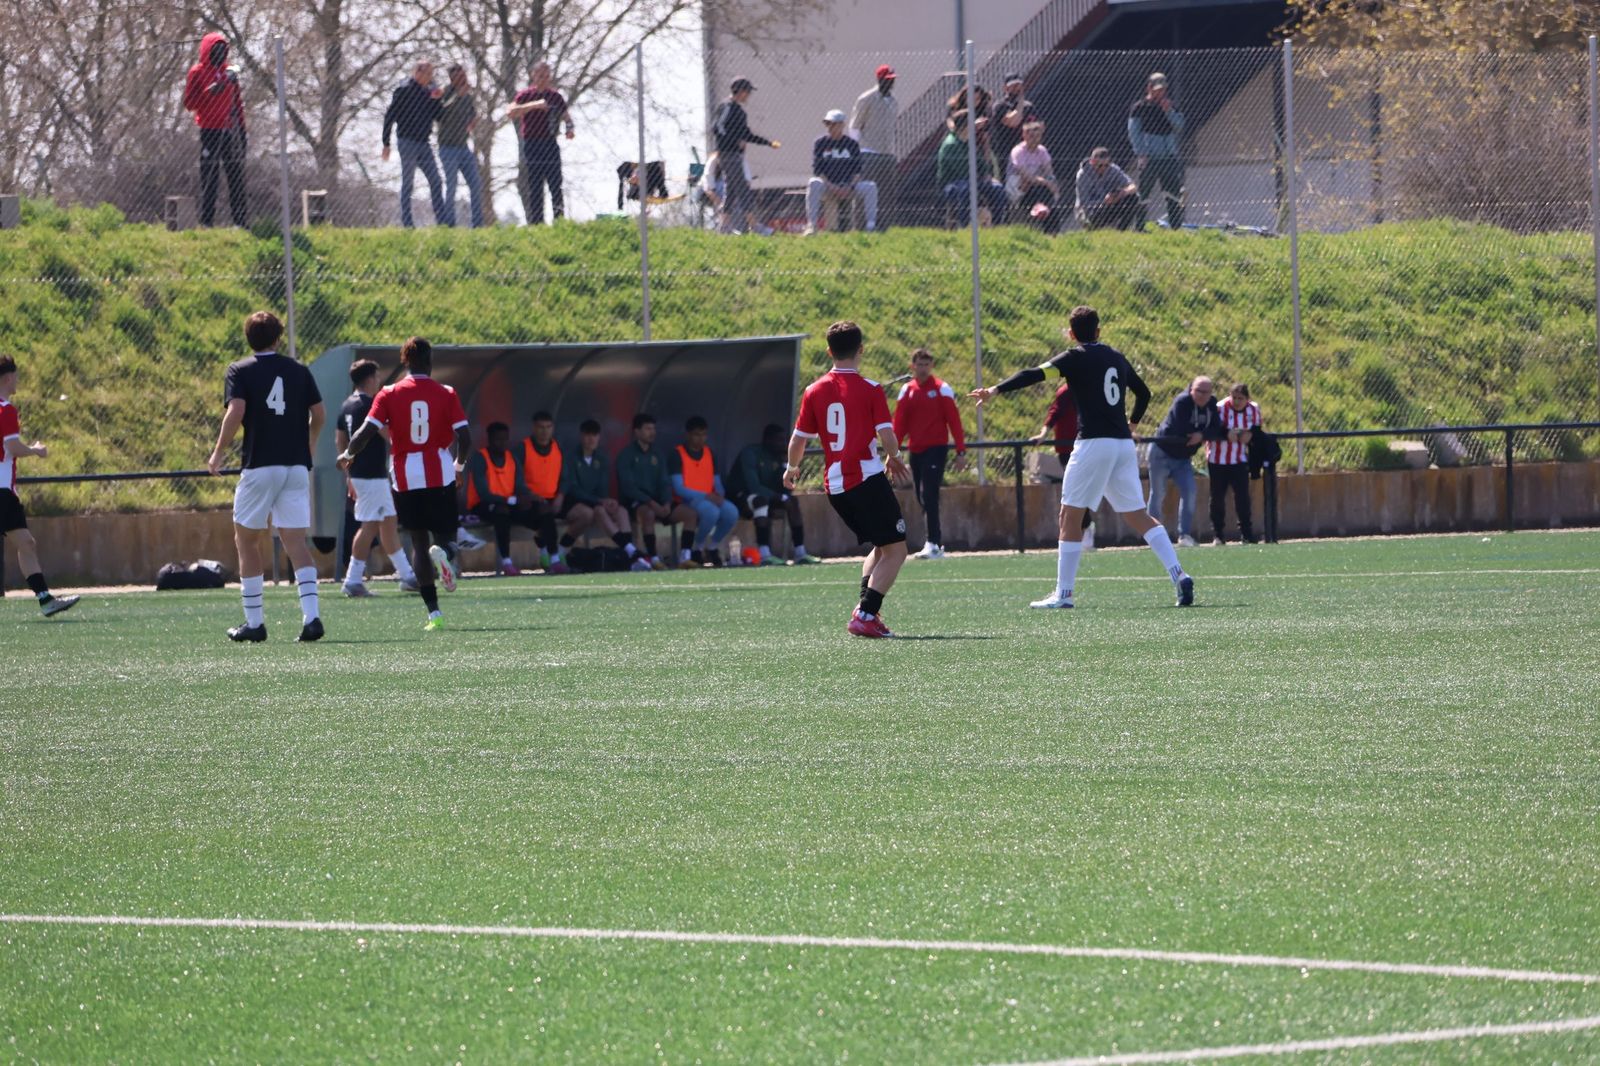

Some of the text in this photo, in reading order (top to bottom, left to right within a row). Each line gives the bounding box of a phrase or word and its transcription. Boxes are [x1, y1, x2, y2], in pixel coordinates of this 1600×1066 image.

[266, 377, 285, 415] 4
[1103, 366, 1120, 406] 6
[410, 400, 429, 444] 8
[826, 402, 846, 452] 9
